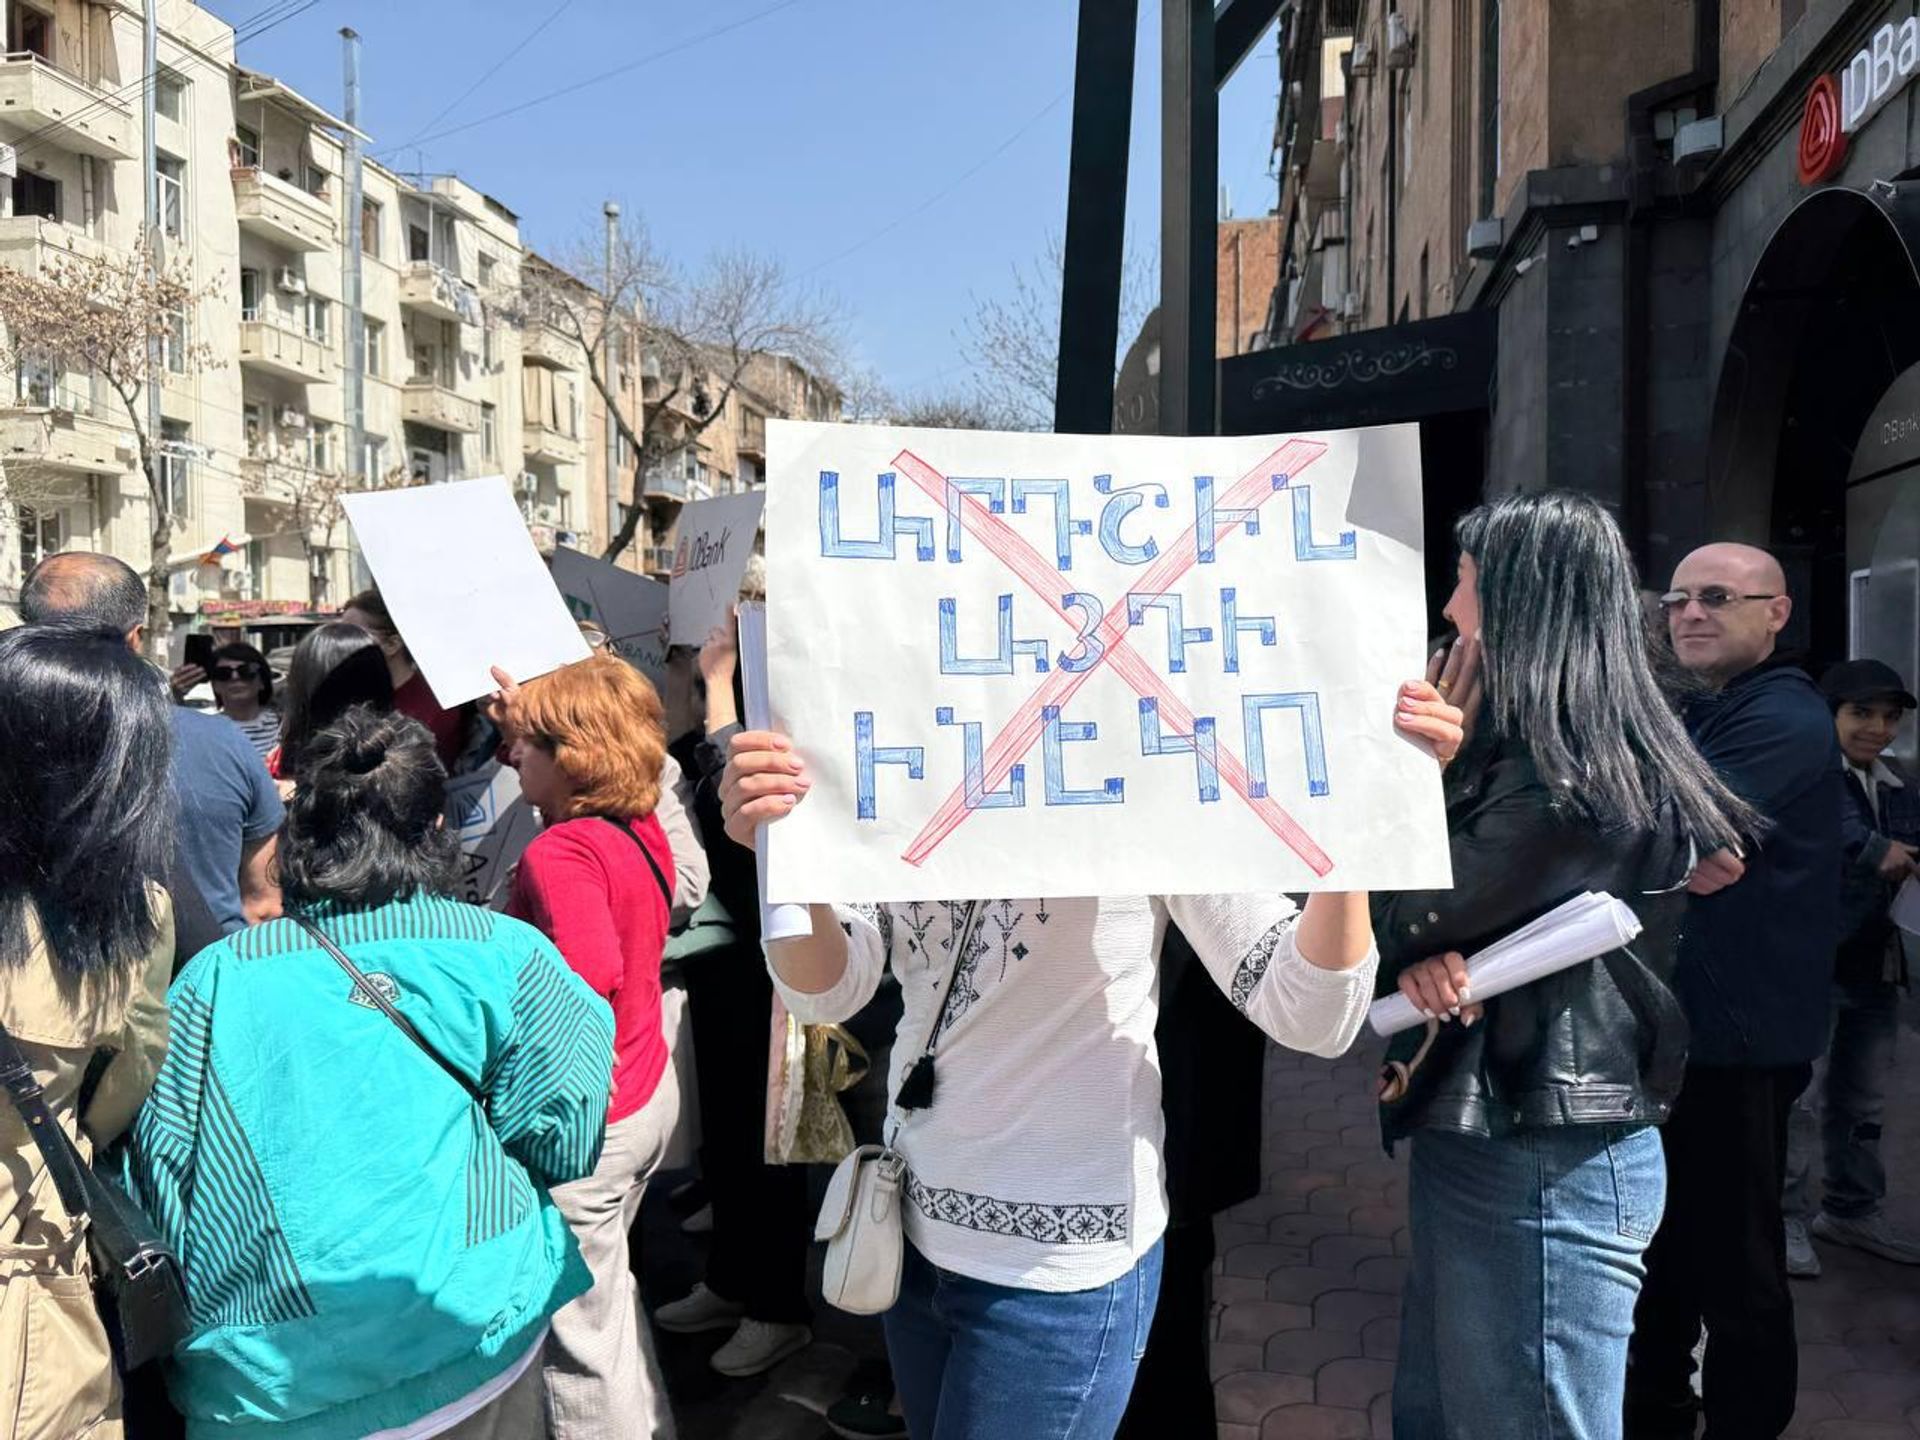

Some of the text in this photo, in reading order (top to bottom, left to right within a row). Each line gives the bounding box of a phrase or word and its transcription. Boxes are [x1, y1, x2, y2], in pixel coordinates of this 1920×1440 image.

[1841, 16, 1920, 133] IDBa
[819, 471, 1357, 571] ԱՐԴՇԻՆ
[938, 587, 1277, 674] ԱՅԴԻ
[854, 692, 1329, 820] ԻՆԵԿՈ
